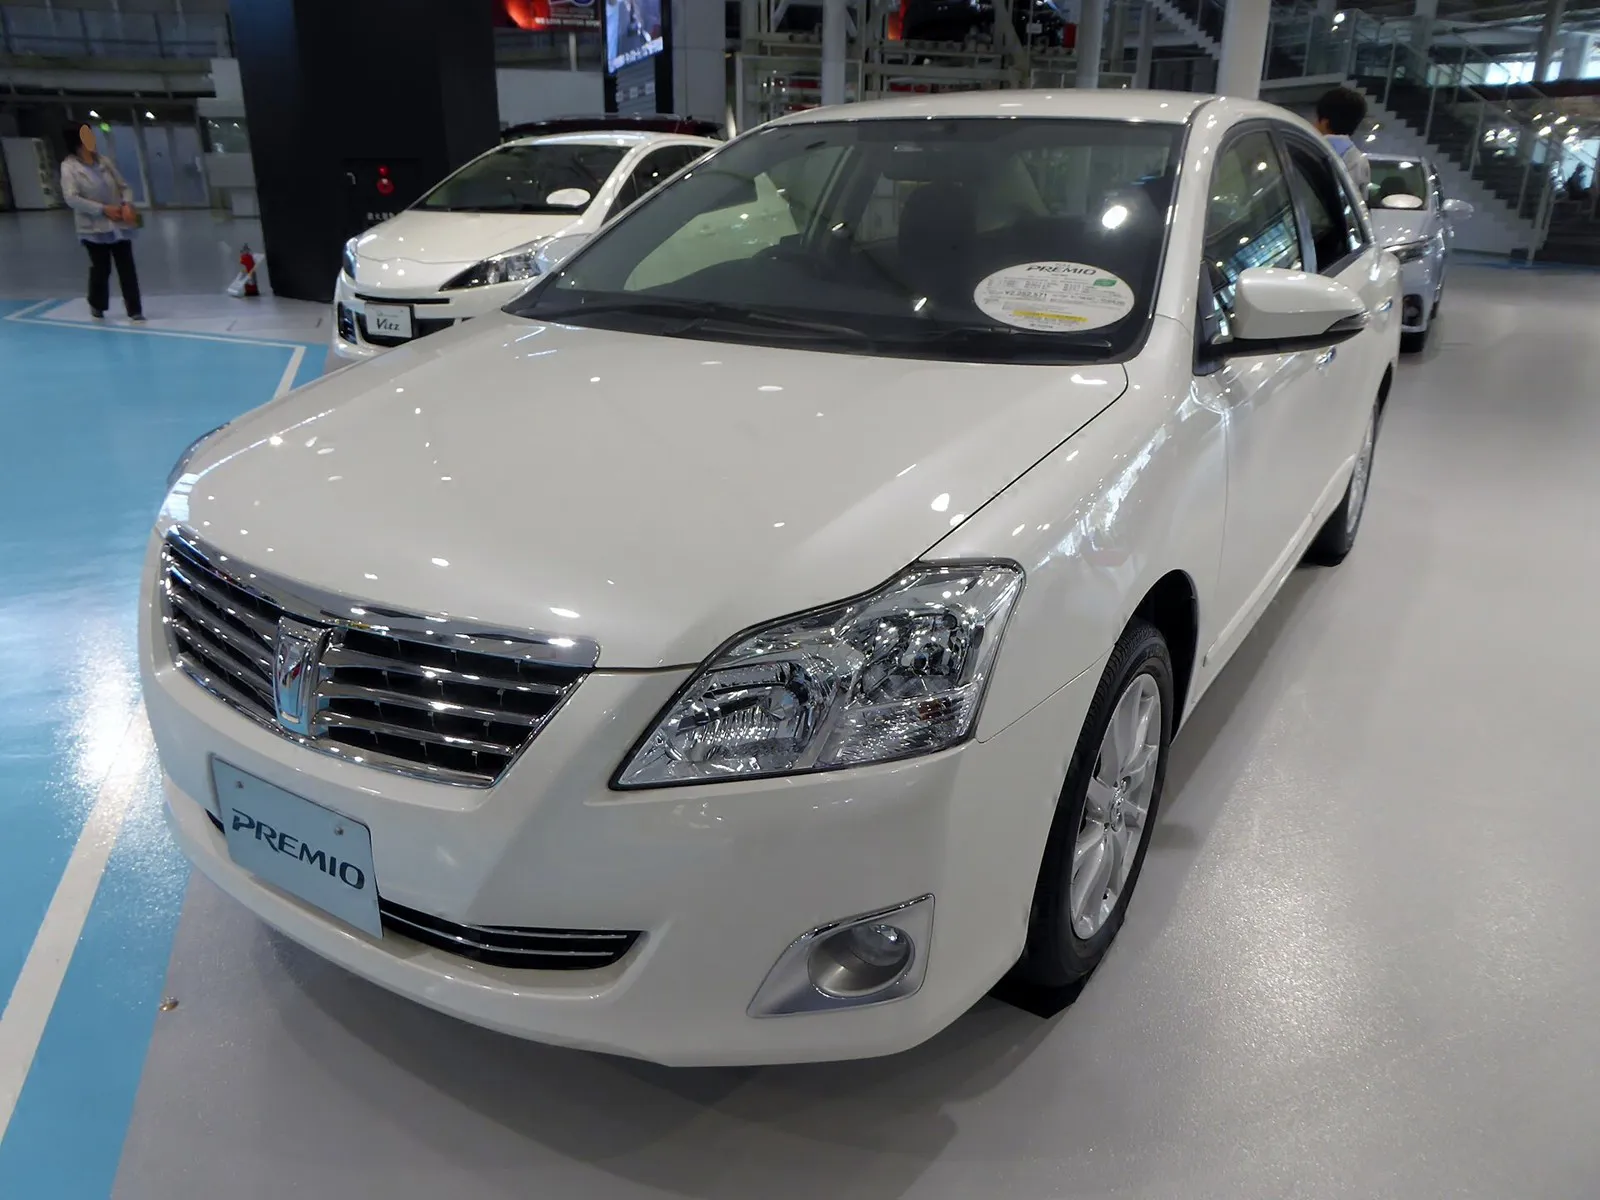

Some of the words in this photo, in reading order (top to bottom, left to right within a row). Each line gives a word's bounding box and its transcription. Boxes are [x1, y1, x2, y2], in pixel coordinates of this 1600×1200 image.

[1026, 265, 1097, 276] PREMIO
[376, 317, 400, 331] Vitz
[232, 807, 365, 891] PREMIO
